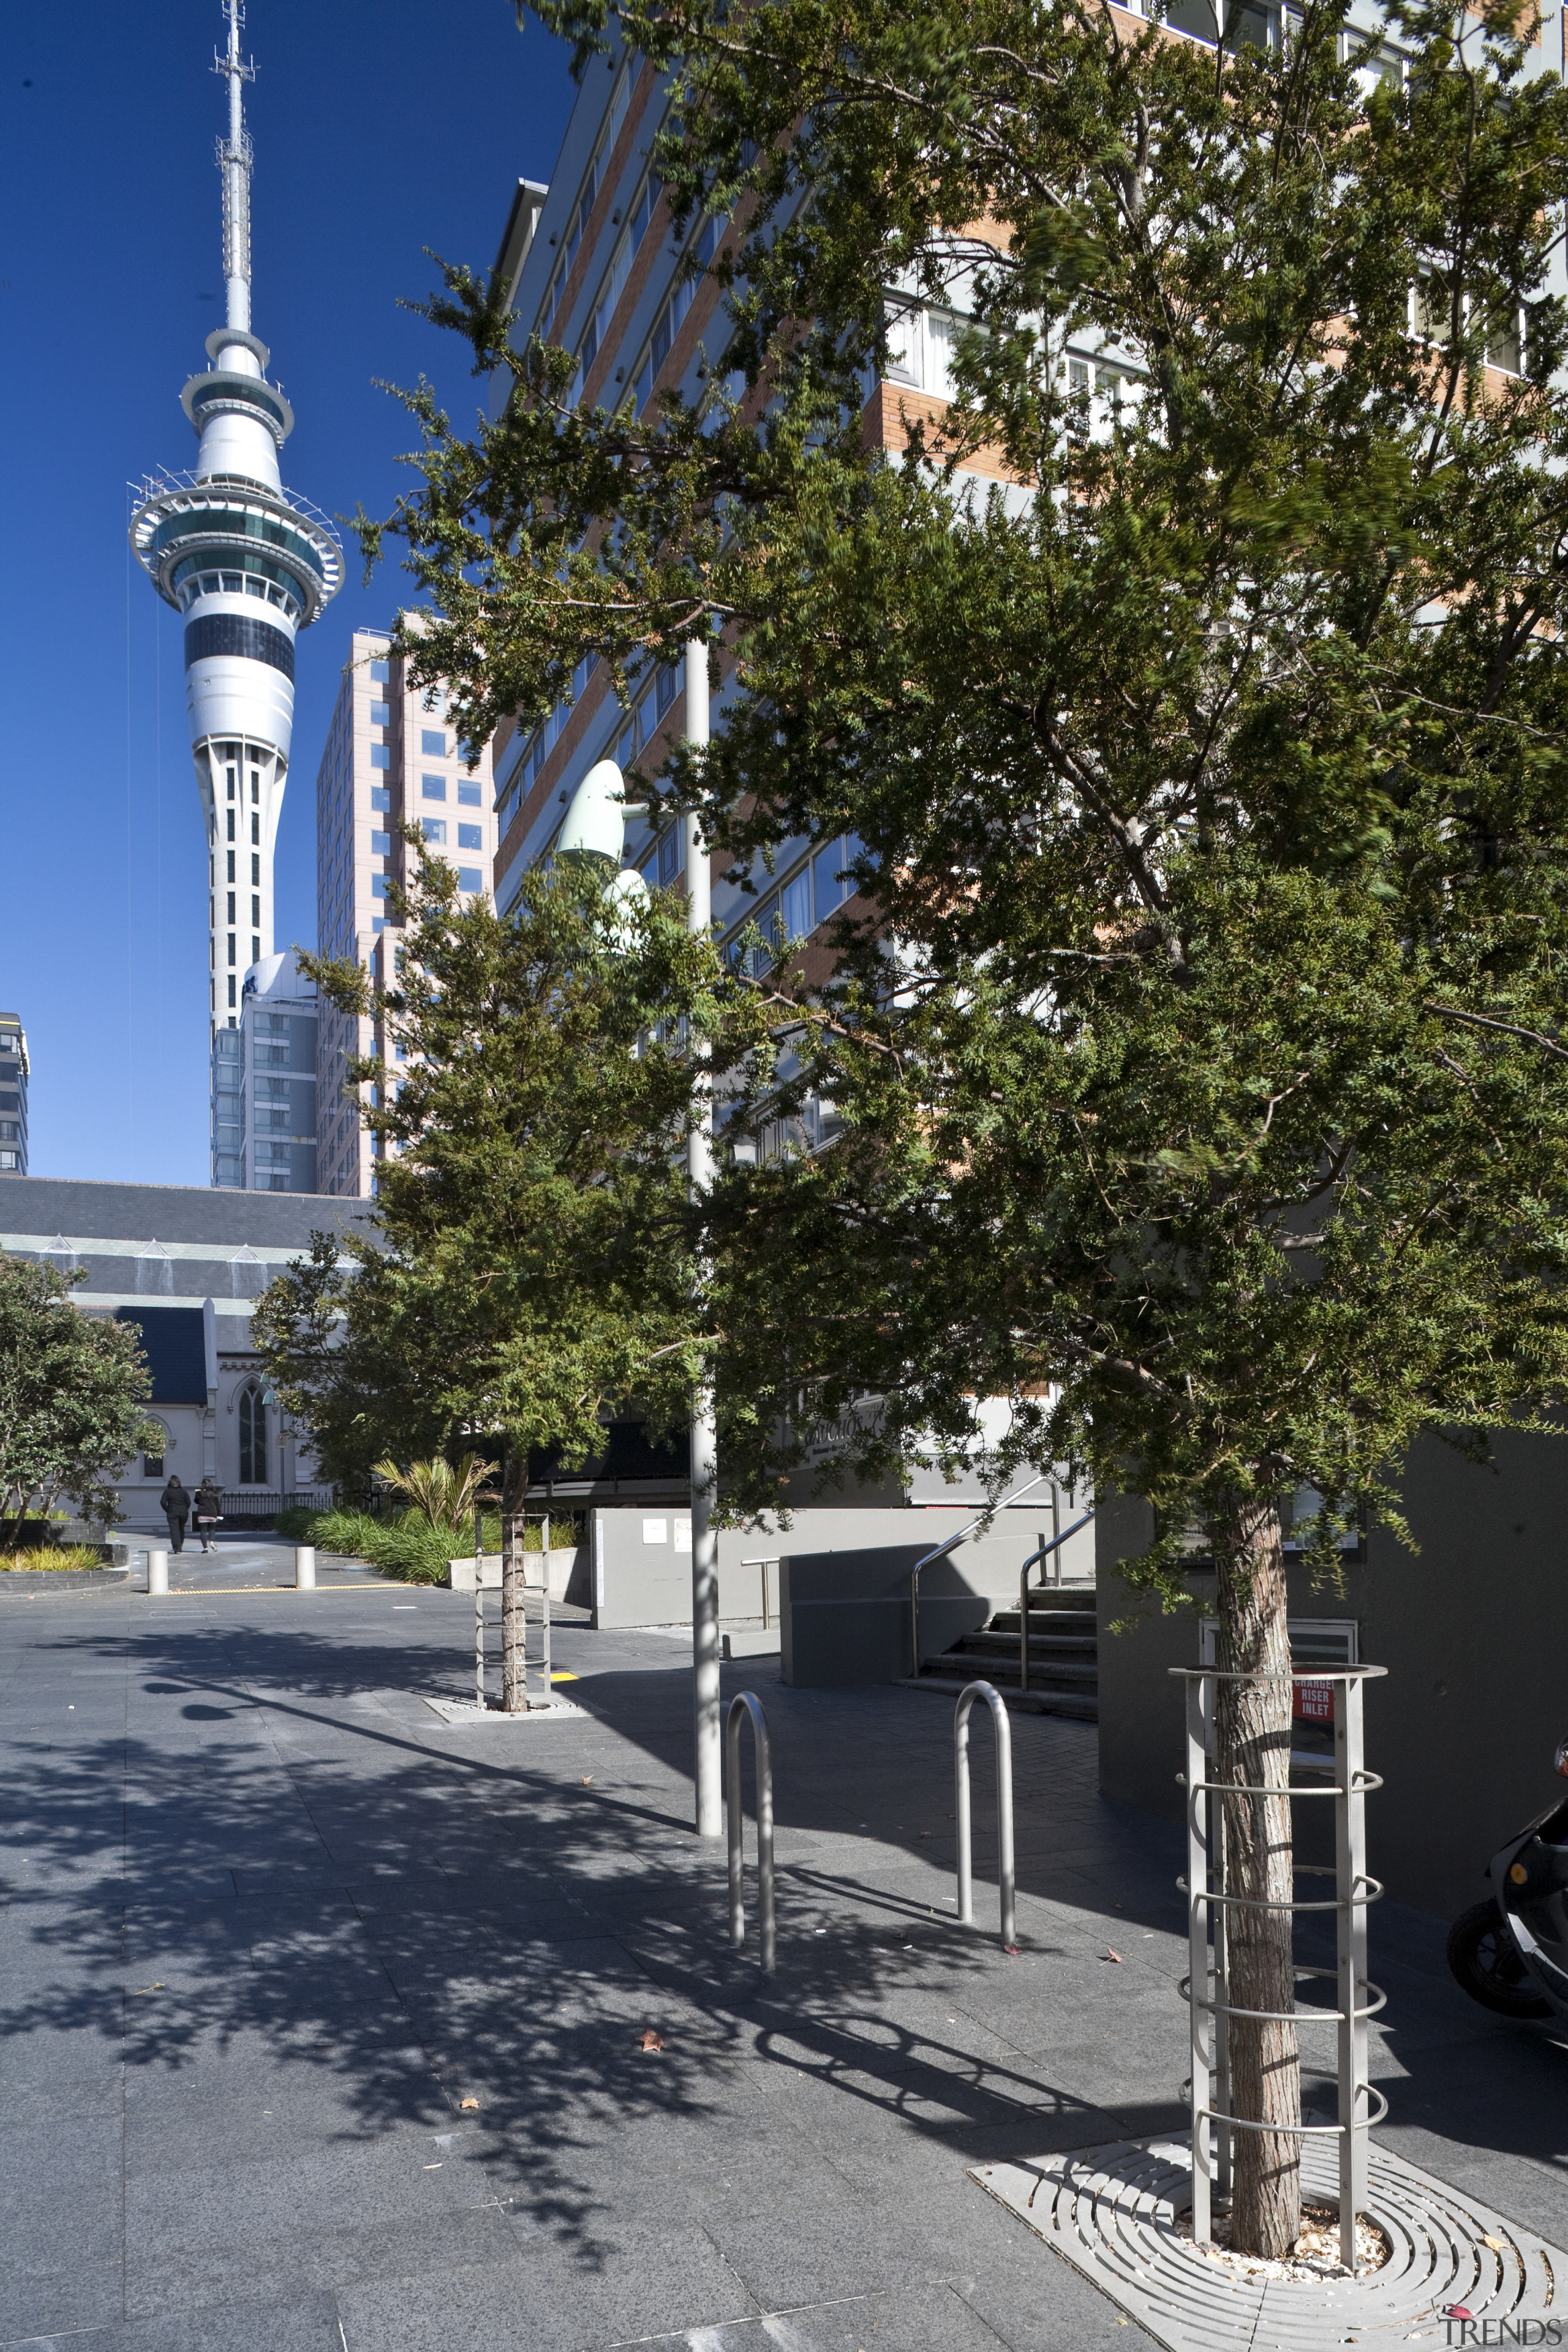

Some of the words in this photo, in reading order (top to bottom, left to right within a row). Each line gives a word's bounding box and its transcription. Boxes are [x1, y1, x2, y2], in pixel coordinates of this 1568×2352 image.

[1294, 1679, 1334, 1690] CHARGE
[1302, 1689, 1329, 1703] RISER
[1302, 1702, 1329, 1716] INLET
